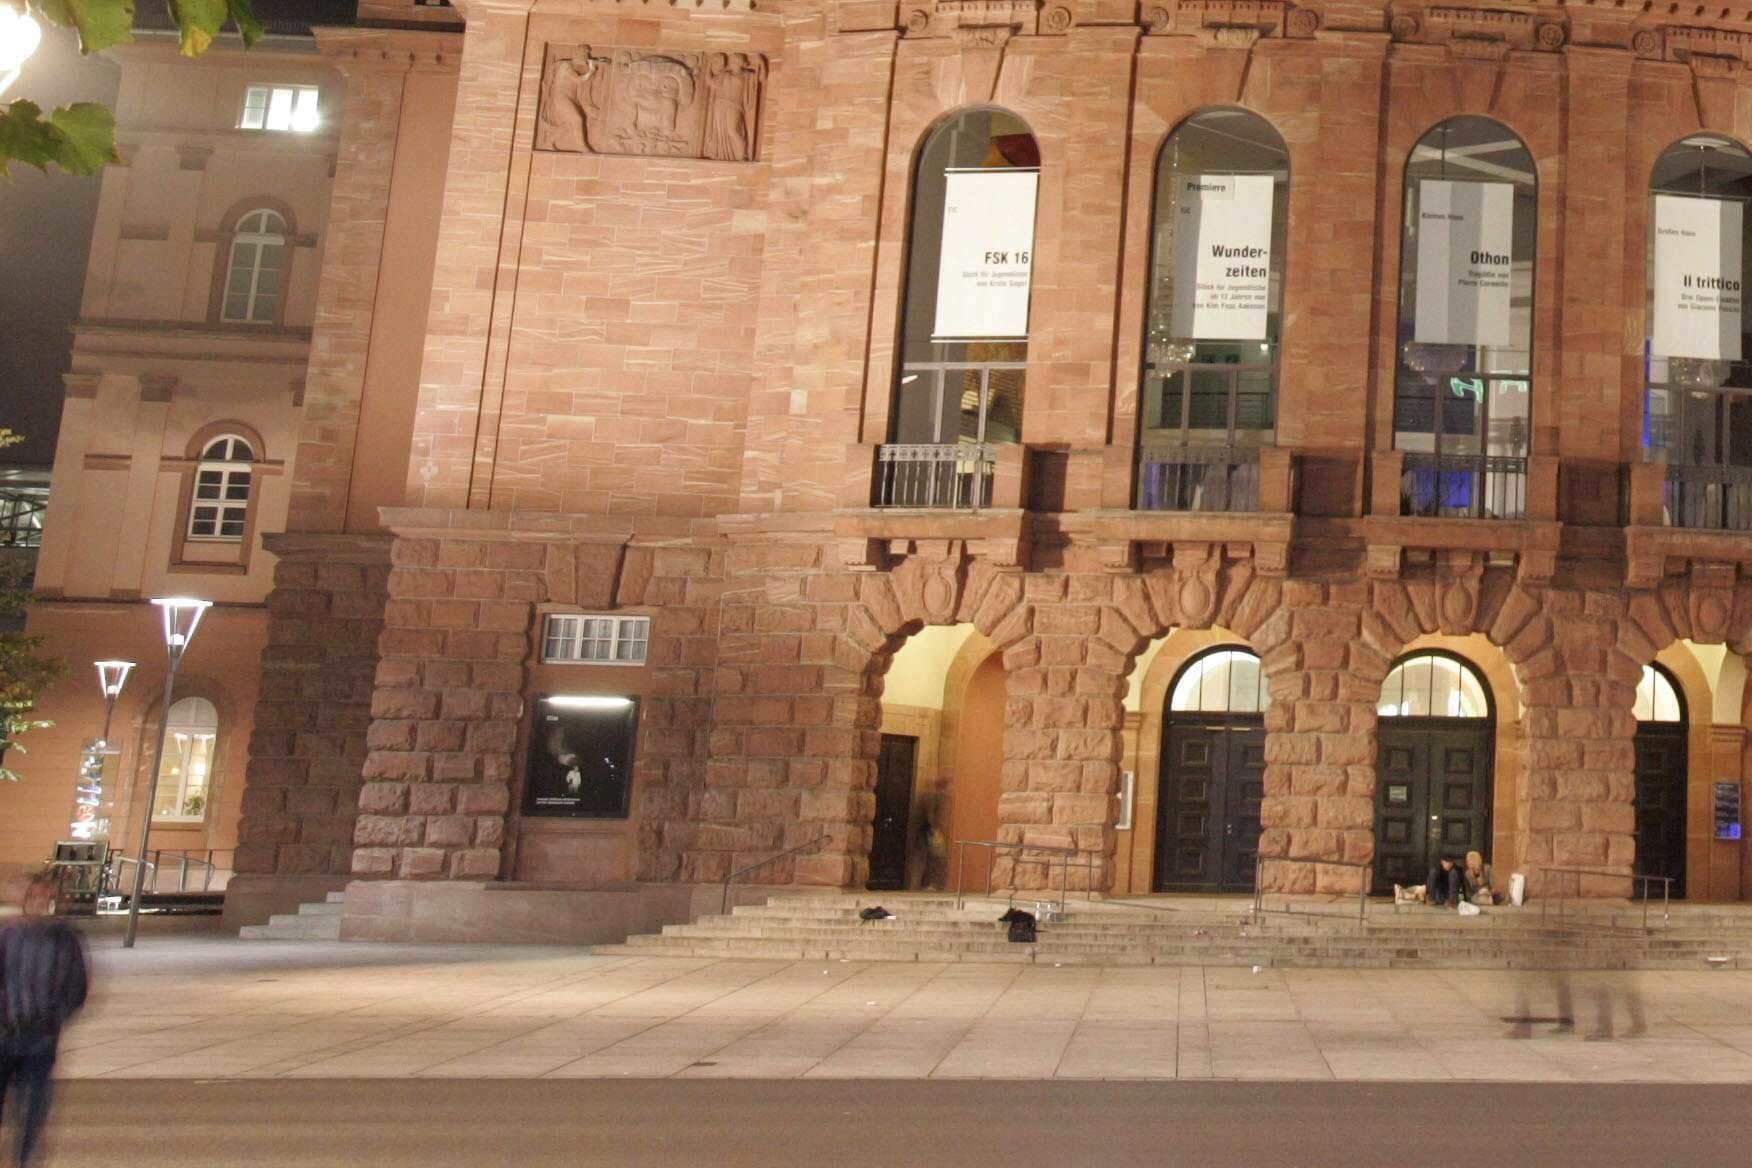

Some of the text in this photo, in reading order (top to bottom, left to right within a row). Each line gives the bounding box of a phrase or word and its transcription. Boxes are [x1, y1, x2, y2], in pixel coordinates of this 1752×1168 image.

[1186, 182, 1226, 192] Premiere
[985, 251, 1029, 265] FSK 16
[1212, 244, 1268, 259] Wunder-
[1470, 250, 1510, 266] Othon
[1225, 265, 1267, 278] zeiten
[1697, 276, 1740, 292] trittico
